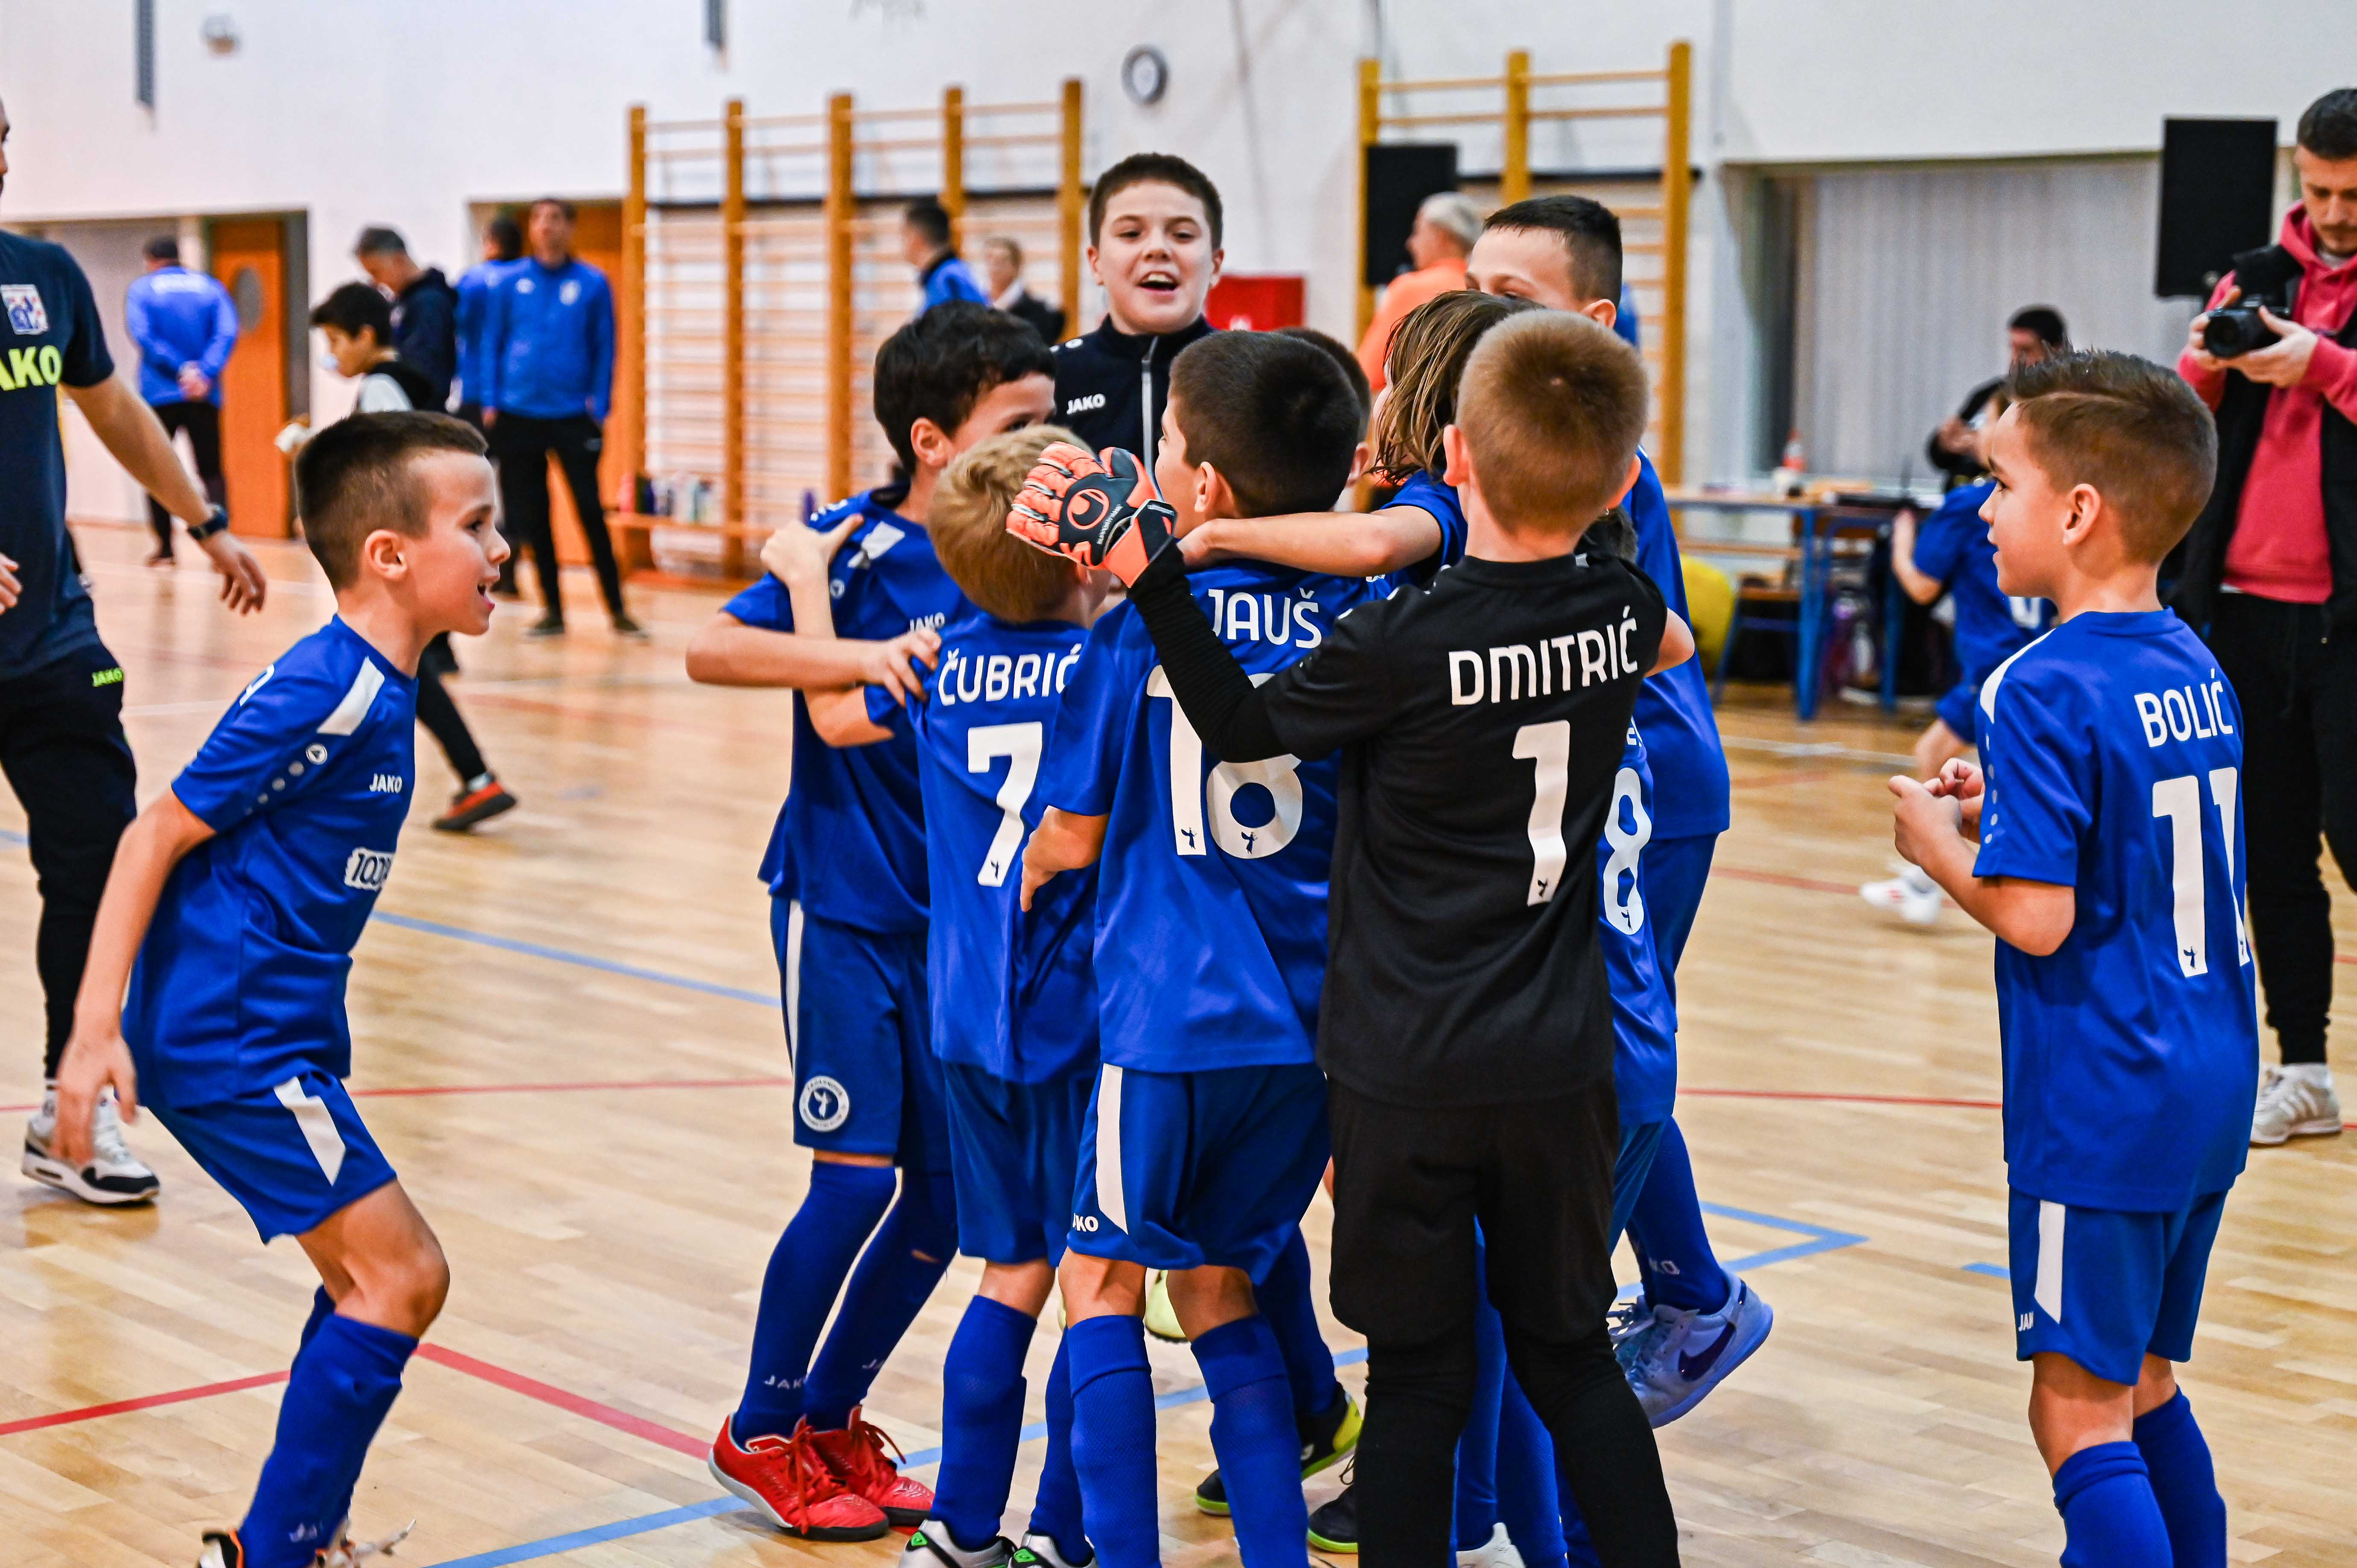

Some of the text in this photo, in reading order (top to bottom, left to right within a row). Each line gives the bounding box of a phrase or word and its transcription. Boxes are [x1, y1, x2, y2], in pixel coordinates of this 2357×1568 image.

[1066, 393, 1106, 415] JAKO
[1448, 605, 1638, 706] DMITRIĆ
[2134, 668, 2234, 748] BOLIĆ
[369, 773, 402, 793] JAKO
[967, 721, 1043, 888] 7
[1147, 664, 1303, 859] 16
[1512, 719, 1570, 907] 1
[1603, 767, 1652, 935] 8
[2152, 767, 2250, 978] 11
[763, 1375, 803, 1390] JAK
